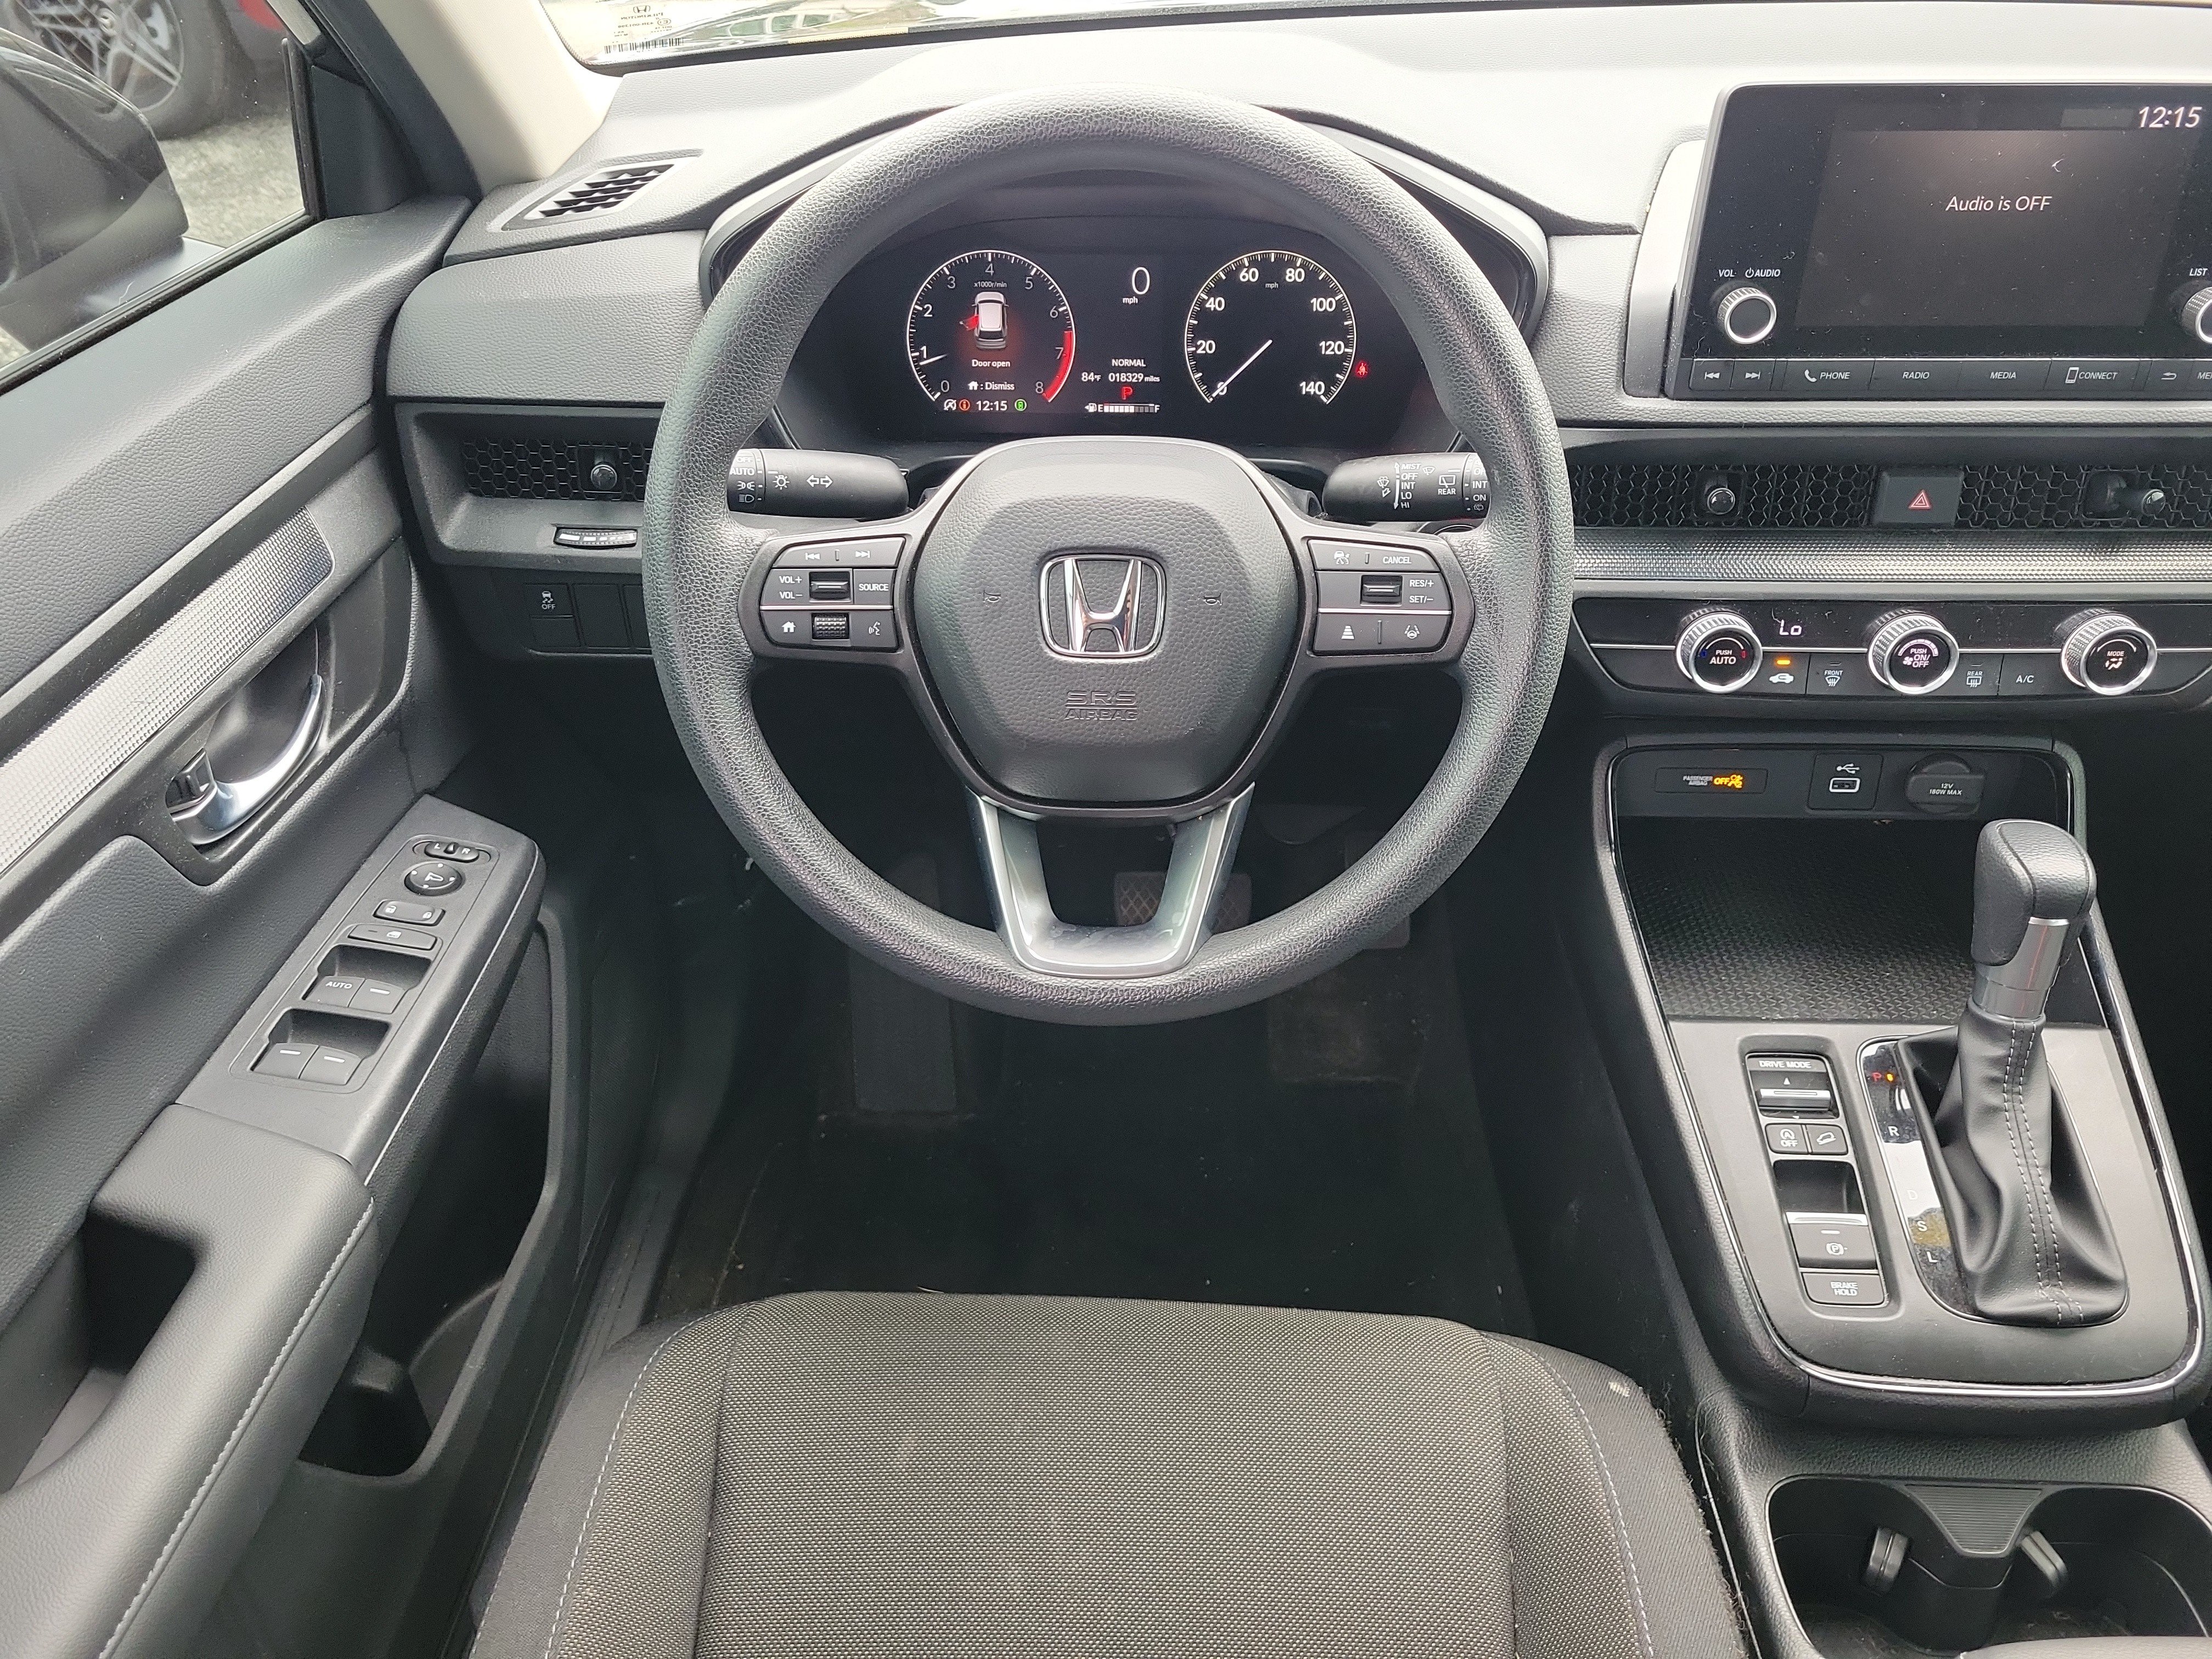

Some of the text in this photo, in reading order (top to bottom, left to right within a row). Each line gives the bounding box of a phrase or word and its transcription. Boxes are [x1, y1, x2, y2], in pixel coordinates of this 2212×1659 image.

[2139, 106, 2202, 128] 12:15
[1945, 195, 2052, 211] Audio is OFF
[985, 263, 994, 275] 4
[1718, 269, 1735, 277] VOL
[1754, 269, 1781, 277] AUDIO
[2190, 268, 2208, 276] LIST
[1240, 268, 1259, 282] 60
[1286, 268, 1305, 282] 80
[947, 276, 956, 289] 3
[1025, 277, 1033, 289] 5
[1132, 267, 1150, 295] 0
[1122, 296, 1138, 304] mph
[1205, 297, 1225, 311] 40
[1311, 298, 1336, 312] 100
[923, 304, 933, 317] 2
[1049, 306, 1058, 318] 6
[920, 346, 927, 358] 1
[1197, 340, 1216, 354] 20
[1319, 341, 1345, 354] 120
[1056, 347, 1064, 359] 7
[1111, 359, 1146, 367] NORMAL
[1108, 373, 1144, 382] 018329
[1820, 371, 1850, 380] PHONE
[1902, 371, 1930, 380] RADIO
[1990, 371, 2017, 380] MEDIA
[2079, 372, 2118, 380] CONNECT
[2197, 371, 2212, 380] ME
[941, 380, 950, 392] 0
[985, 381, 1015, 390] Dismiss
[1035, 381, 1043, 393] 8
[1299, 381, 1325, 395] 140
[1121, 386, 1133, 400] P
[976, 400, 1007, 411] 12:15
[1098, 404, 1104, 413] E
[1155, 405, 1160, 413] F
[1401, 482, 1416, 490] INT
[1472, 481, 1488, 489] INT
[779, 575, 803, 584] VOL+
[1409, 579, 1434, 588] RES/+
[2016, 675, 2035, 683] A/C
[1066, 690, 1136, 706] SRS
[325, 981, 353, 989] AUTO
[1872, 1072, 1882, 1081] P
[1888, 1126, 1900, 1137] R
[1917, 1221, 1928, 1232] S
[1926, 1251, 1938, 1262] L
